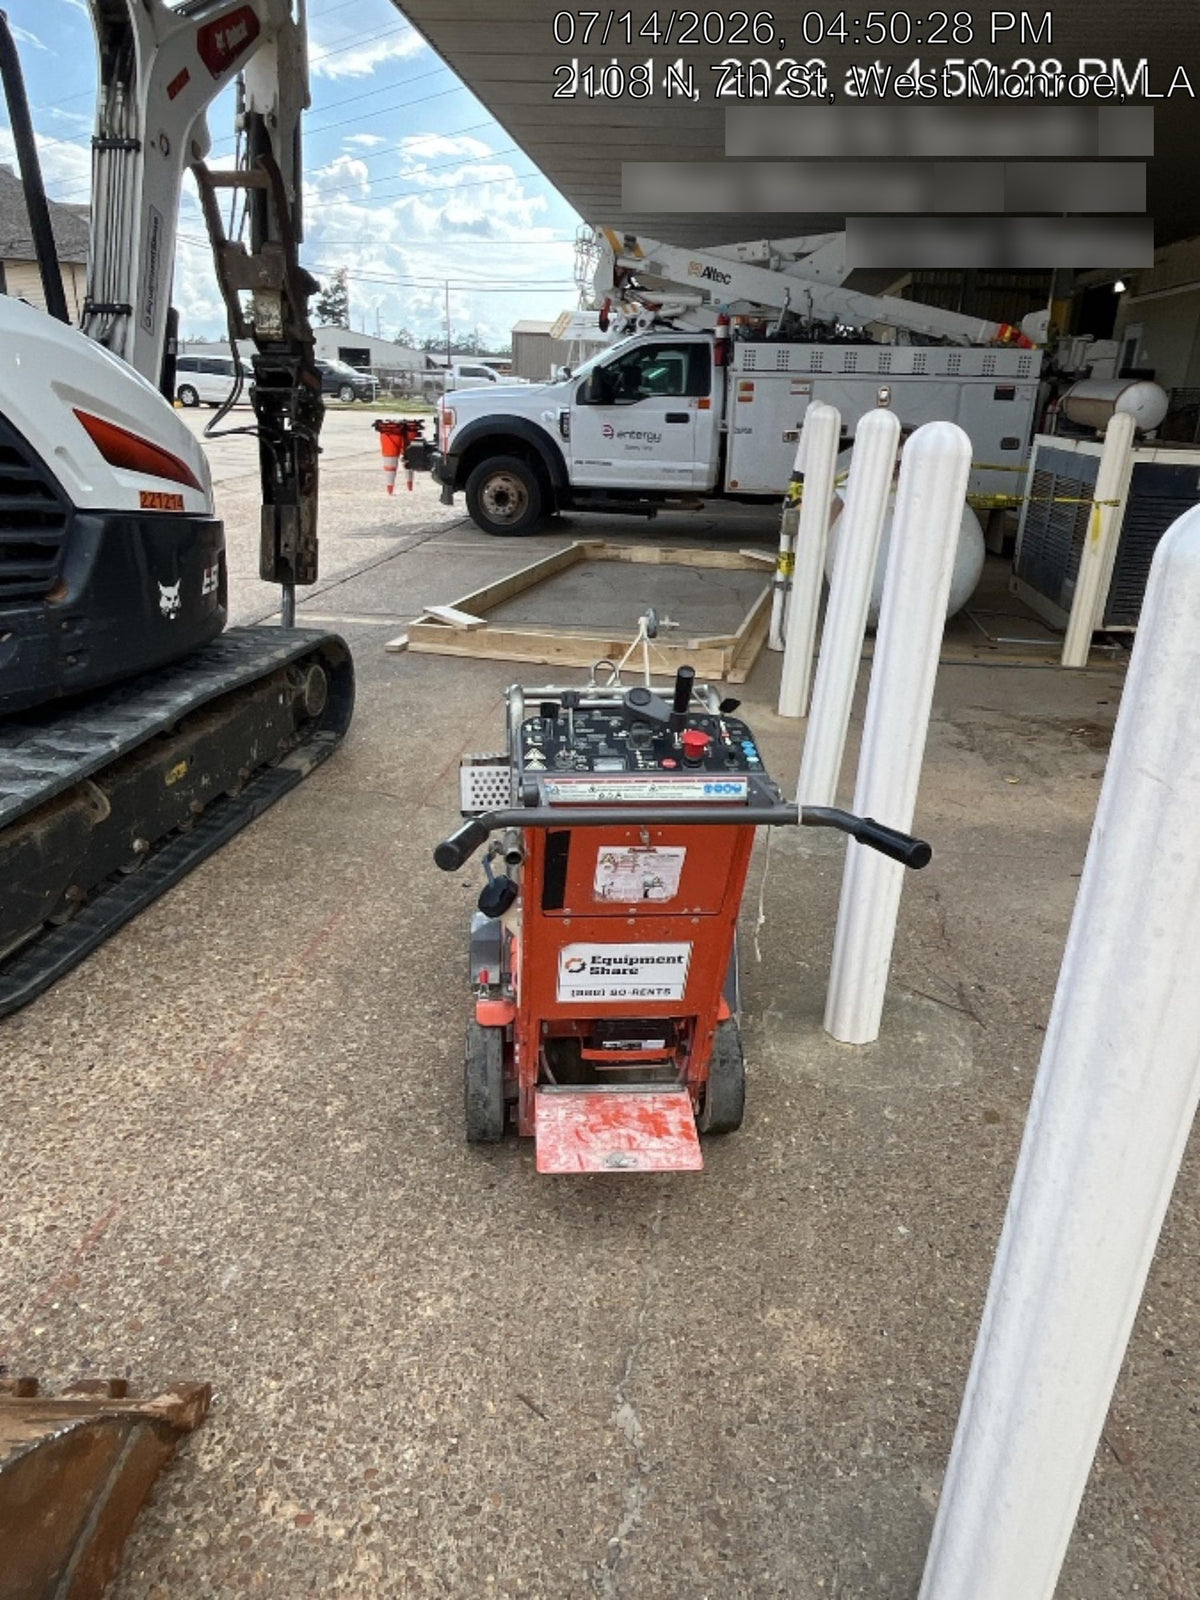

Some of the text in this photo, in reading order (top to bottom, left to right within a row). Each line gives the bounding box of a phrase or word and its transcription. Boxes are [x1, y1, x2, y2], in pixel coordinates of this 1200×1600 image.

[700, 266, 732, 286] Altec
[616, 430, 662, 443] entergy
[590, 954, 684, 966] Equipment
[589, 966, 640, 976] Share
